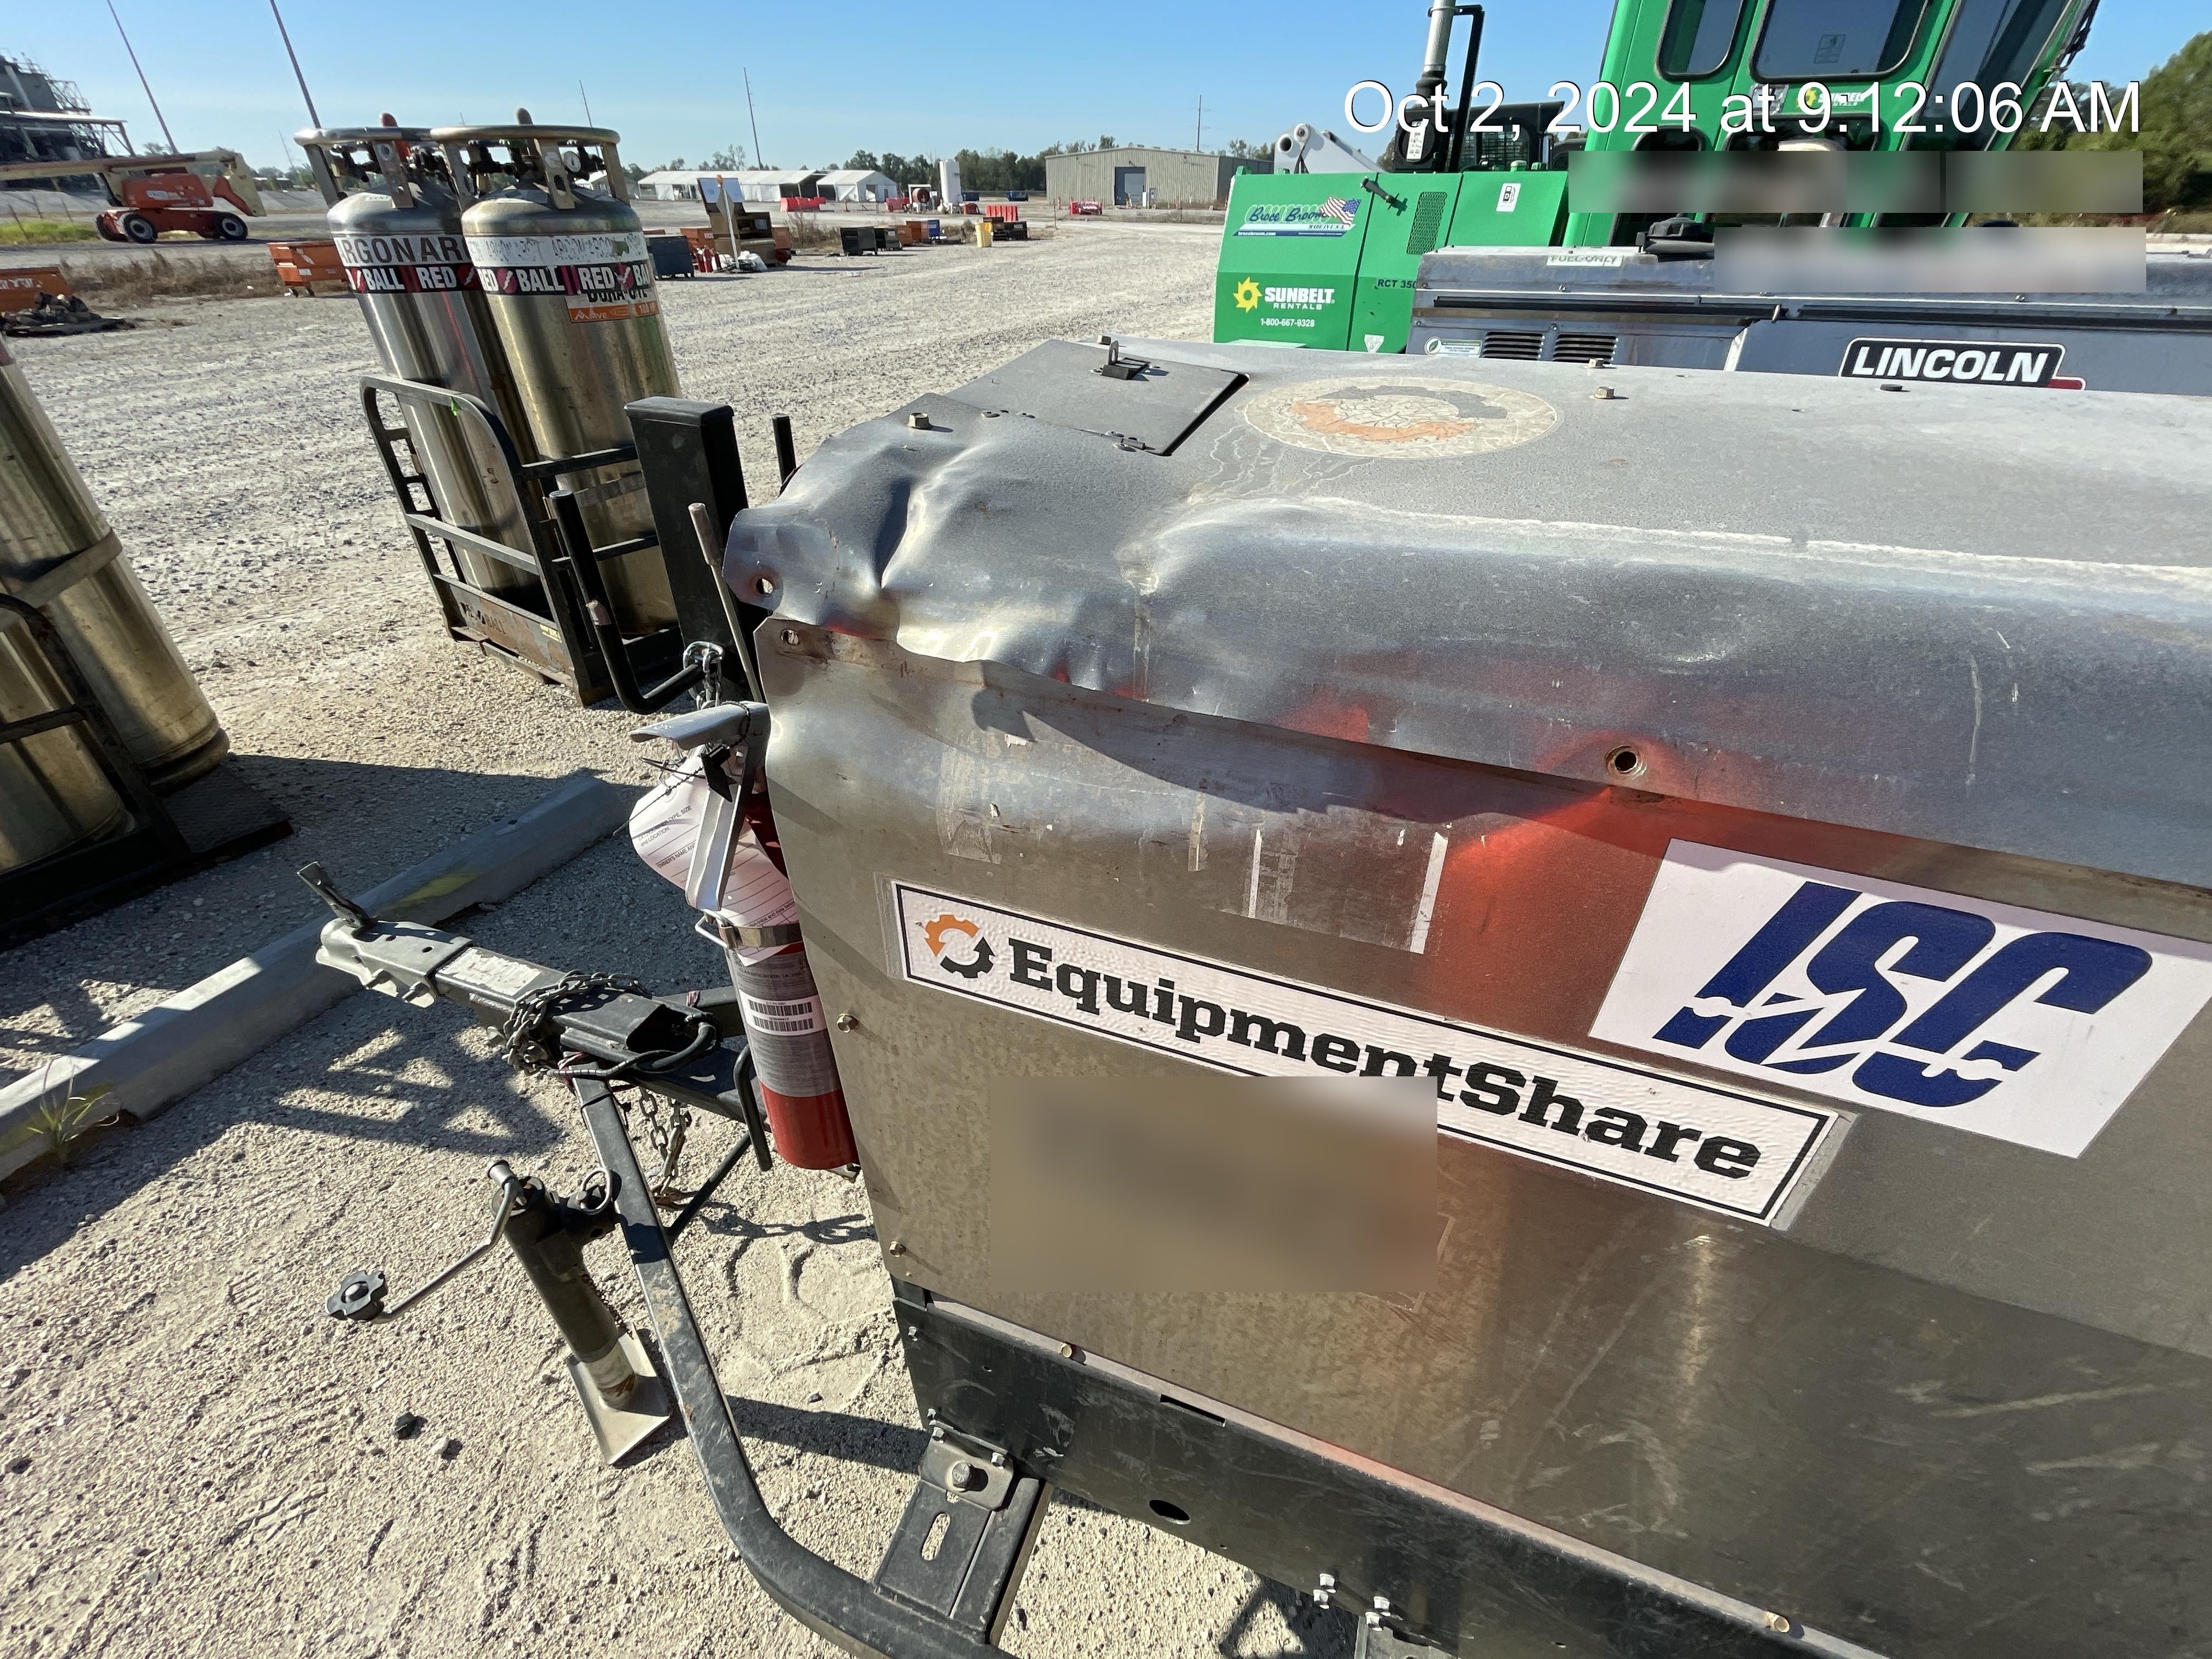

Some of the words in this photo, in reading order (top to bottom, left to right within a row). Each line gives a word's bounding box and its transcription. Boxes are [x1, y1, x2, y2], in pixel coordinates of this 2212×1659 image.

[1249, 206, 1280, 222] Broce
[420, 236, 472, 263] AR
[1551, 254, 1581, 262] FUEL
[362, 267, 405, 291] BALL
[415, 266, 457, 290] RED
[477, 268, 500, 292] RED
[516, 265, 566, 292] BALL
[578, 266, 616, 290] RED
[632, 263, 652, 287] BA
[1378, 278, 1398, 289] RCT
[1264, 286, 1335, 303] SUNBELT
[1273, 302, 1323, 311] RENTALS
[1852, 346, 2050, 383] LINCOLN
[681, 805, 692, 815] SIZE
[674, 848, 689, 860] NAME
[1654, 881, 2154, 1108] ISC
[1008, 937, 1762, 1180] EquipmentShare
